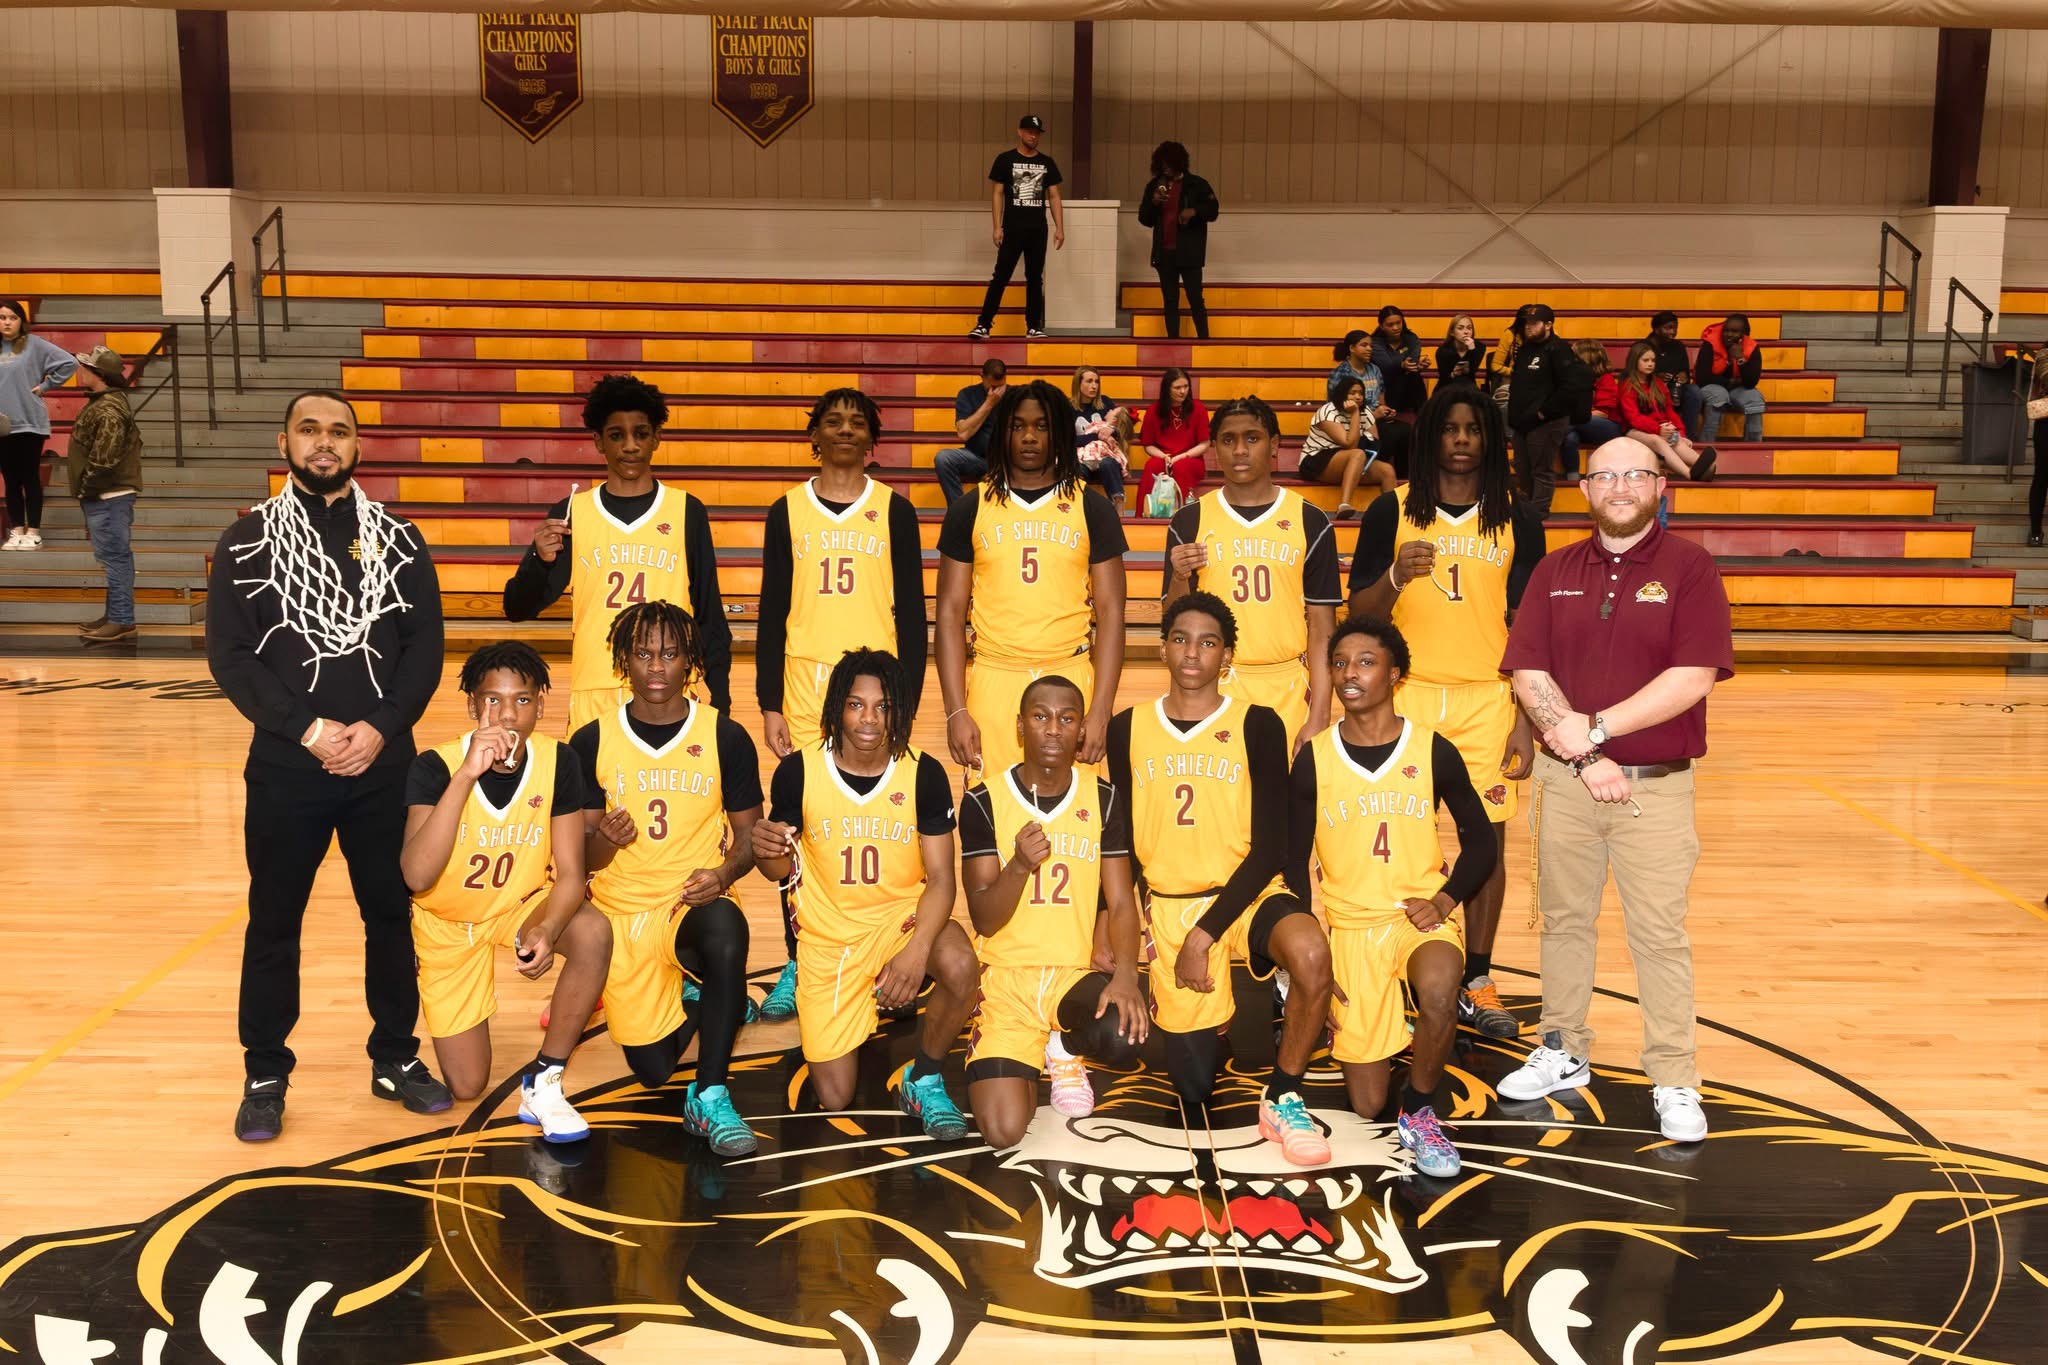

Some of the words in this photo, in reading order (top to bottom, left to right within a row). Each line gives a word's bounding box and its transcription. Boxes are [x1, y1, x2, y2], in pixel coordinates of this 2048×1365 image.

[486, 30, 574, 53] CHAMPIONS
[720, 33, 806, 58] CHAMPIONS
[514, 54, 547, 71] GIRLS
[725, 57, 753, 75] BOYS
[757, 57, 765, 75] &
[769, 58, 801, 76] GIRLS
[804, 533, 811, 553] F
[821, 529, 887, 559] SHIELDS
[995, 524, 1003, 543] F
[1013, 520, 1082, 549] SHIELDS
[593, 547, 602, 568] F
[609, 543, 679, 574] SHIELDS
[1021, 546, 1039, 584] 5
[1215, 542, 1223, 561] F
[1233, 537, 1301, 567] SHIELDS
[1437, 535, 1509, 568] SHIELDS
[604, 570, 647, 609] 24
[818, 556, 855, 595] 15
[1231, 563, 1272, 603] 30
[1447, 562, 1464, 602] 1
[637, 768, 714, 797] SHIELDS
[1146, 758, 1155, 781] F
[1165, 753, 1242, 784] SHIELDS
[647, 797, 669, 841] 3
[1174, 782, 1195, 827] 2
[1338, 799, 1348, 822] F
[1357, 791, 1430, 820] SHIELDS
[460, 823, 468, 845] F
[822, 818, 832, 840] F
[841, 815, 916, 844] SHIELDS
[1372, 820, 1391, 864] 4
[1046, 832, 1100, 863] IELDS
[463, 851, 515, 890] 20
[839, 844, 880, 886] 10
[1029, 862, 1071, 905] 12
